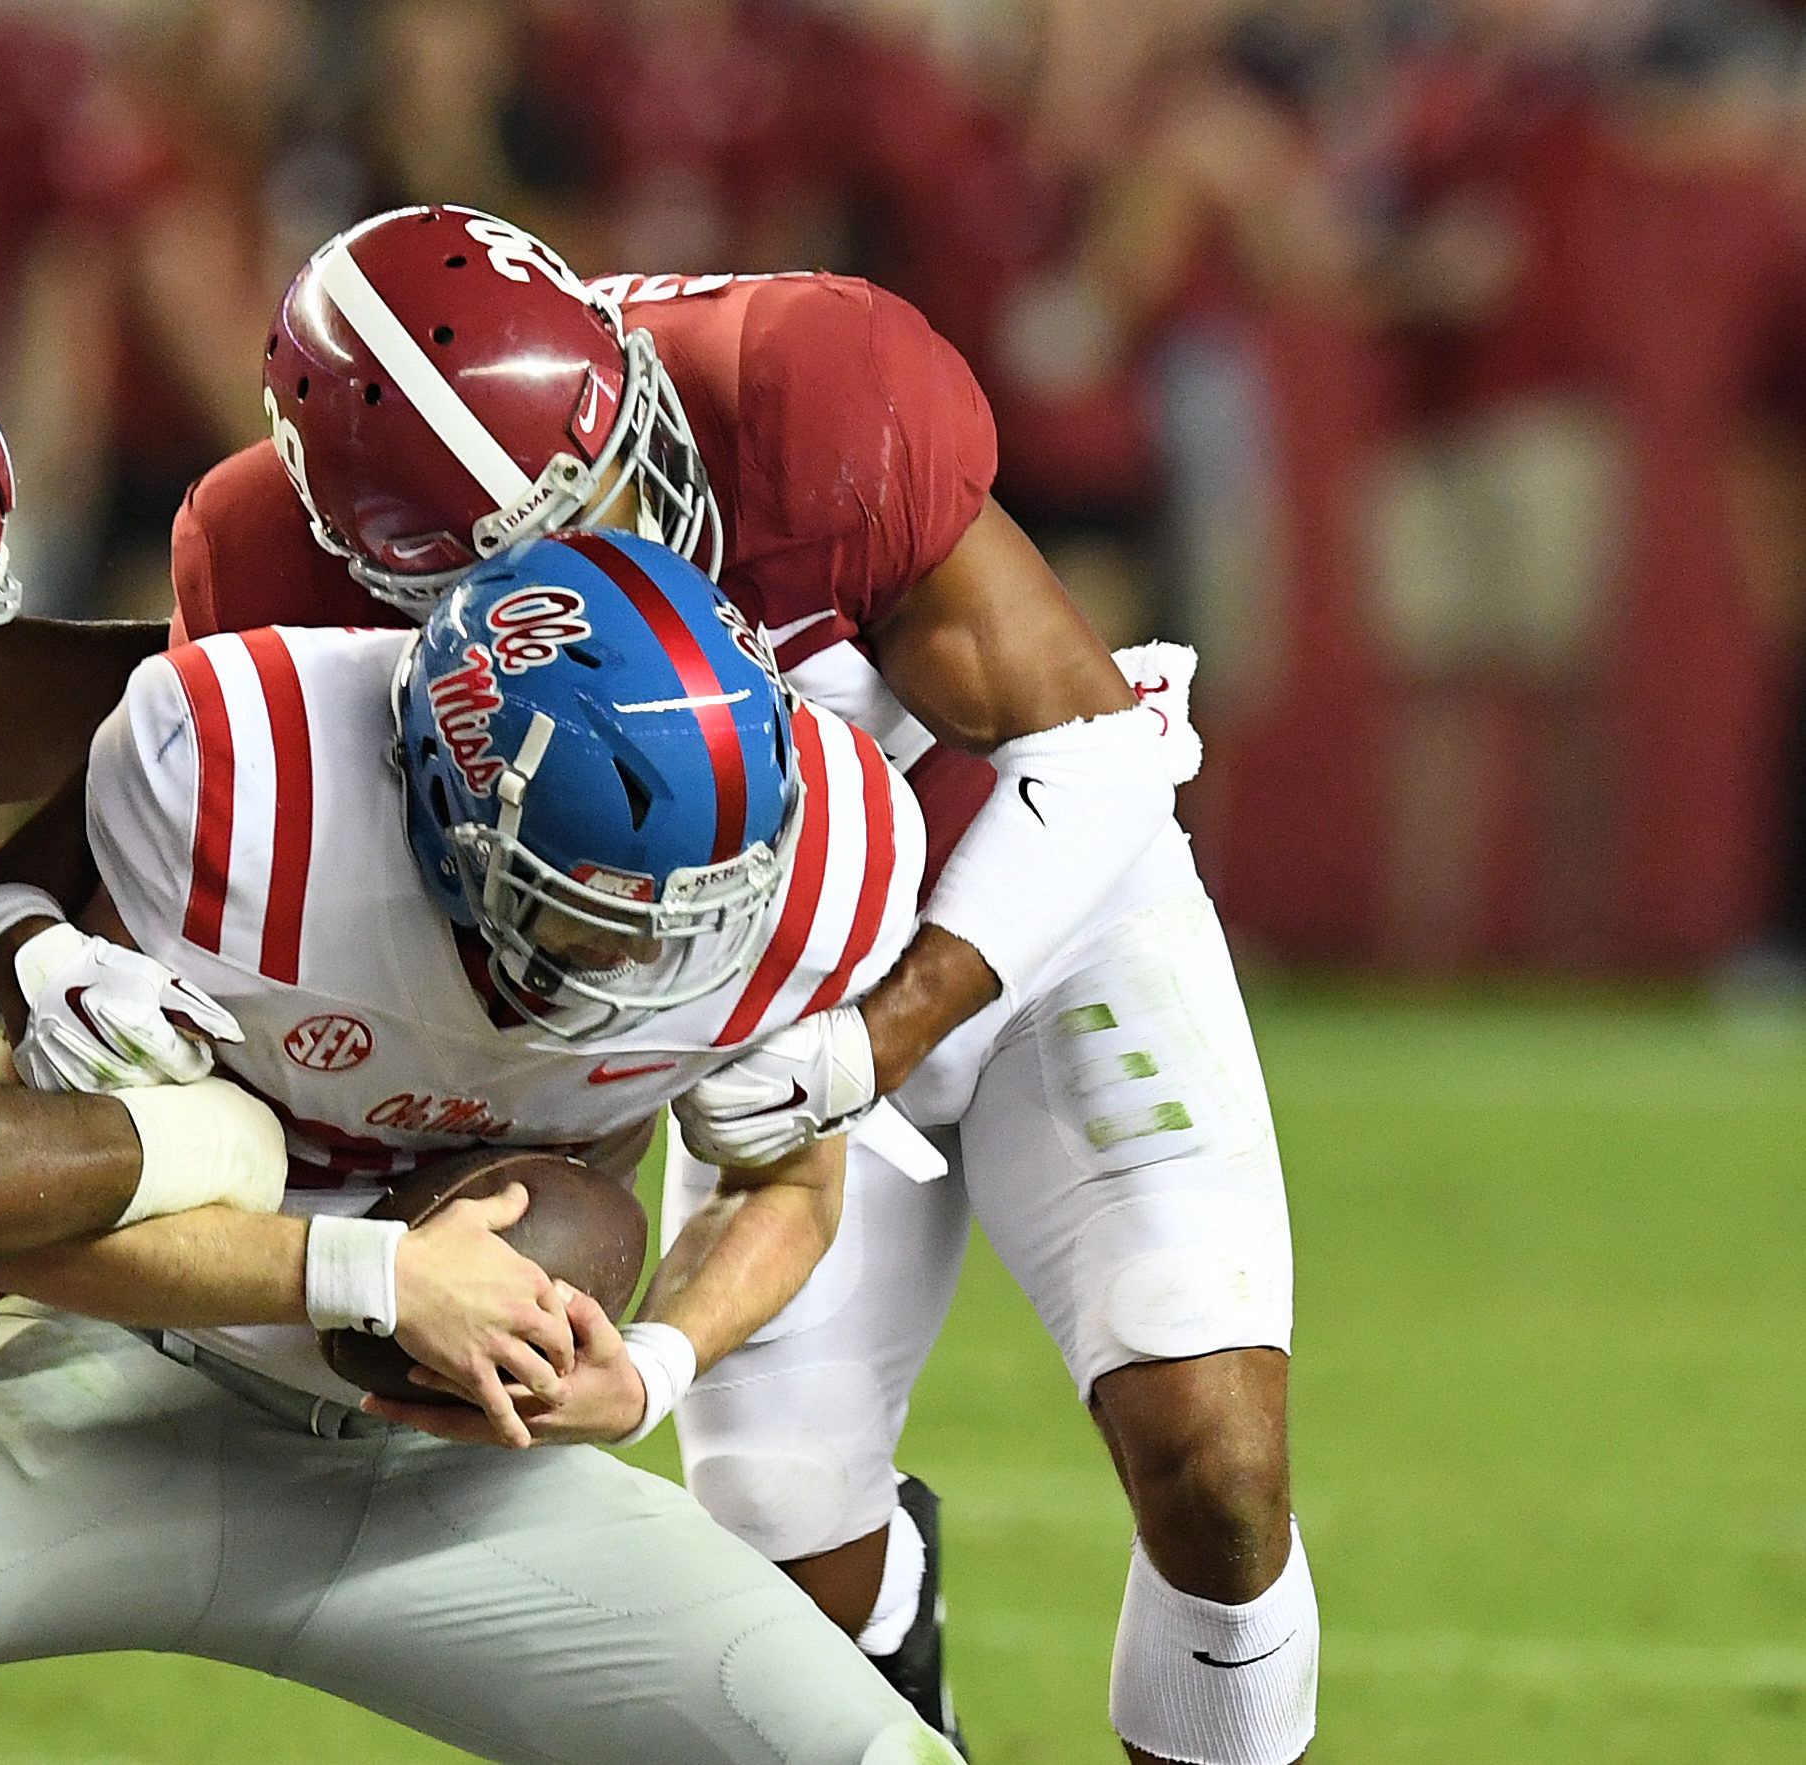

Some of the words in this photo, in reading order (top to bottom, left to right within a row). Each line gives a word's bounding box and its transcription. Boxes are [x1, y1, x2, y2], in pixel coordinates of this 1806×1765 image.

[506, 488, 554, 528] BAMA
[485, 585, 592, 675] Ole
[429, 643, 505, 798] Miss
[288, 1018, 368, 1067] SEC
